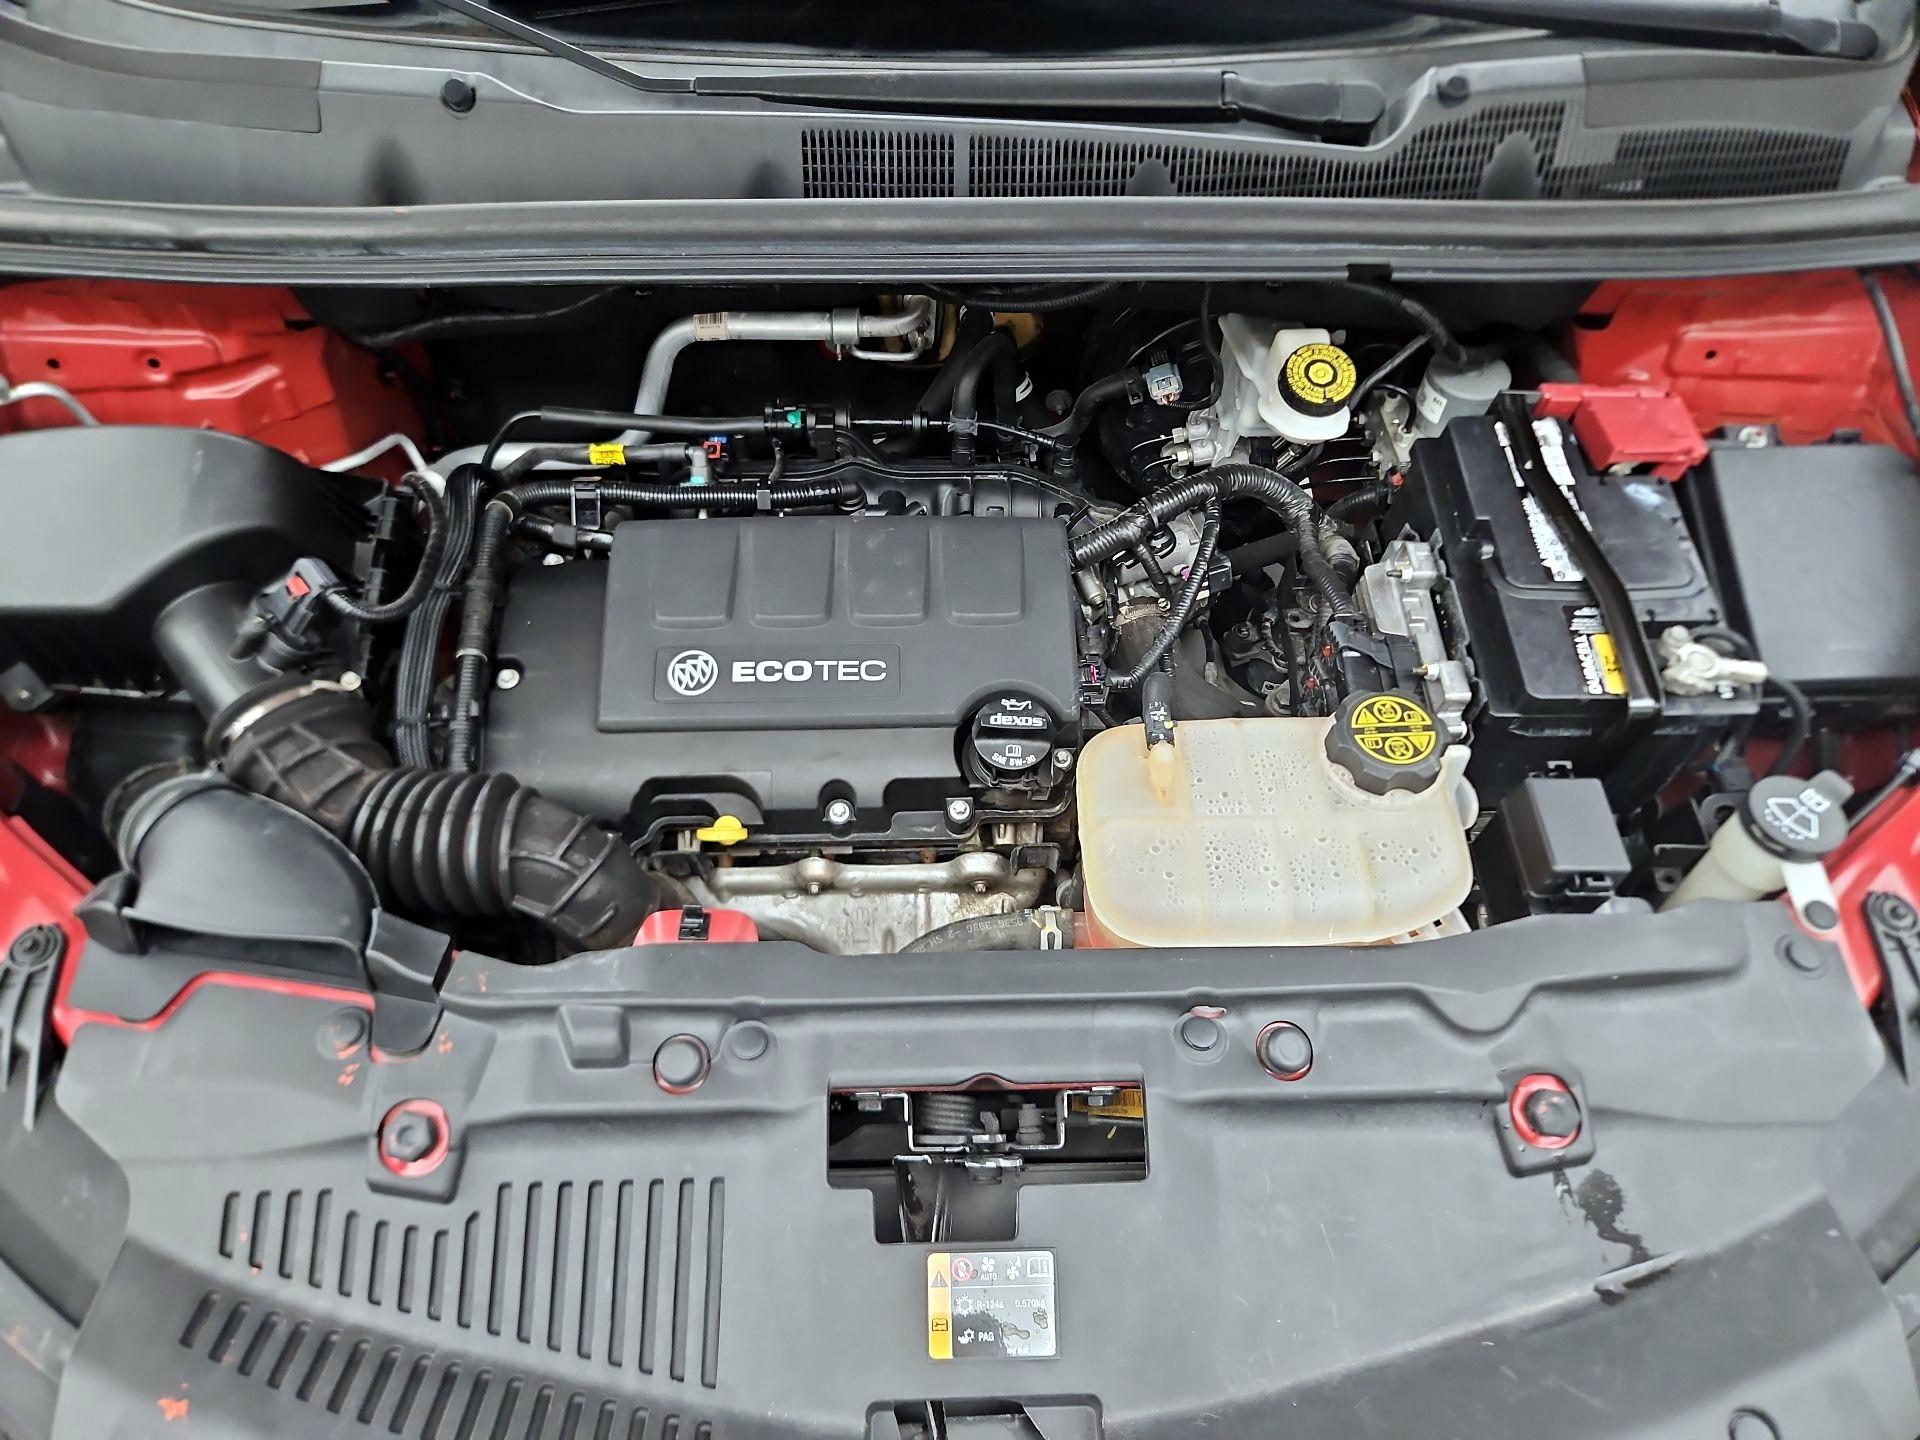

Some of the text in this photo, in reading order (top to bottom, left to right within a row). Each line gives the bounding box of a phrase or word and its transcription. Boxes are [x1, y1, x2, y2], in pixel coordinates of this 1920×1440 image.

[731, 660, 887, 682] ECOTEC
[989, 712, 1044, 727] dexos
[991, 752, 1037, 767] SAE 5W-30
[980, 1272, 998, 1281] AUTO
[976, 1299, 1005, 1310] R-134a
[978, 1331, 995, 1342] PAG
